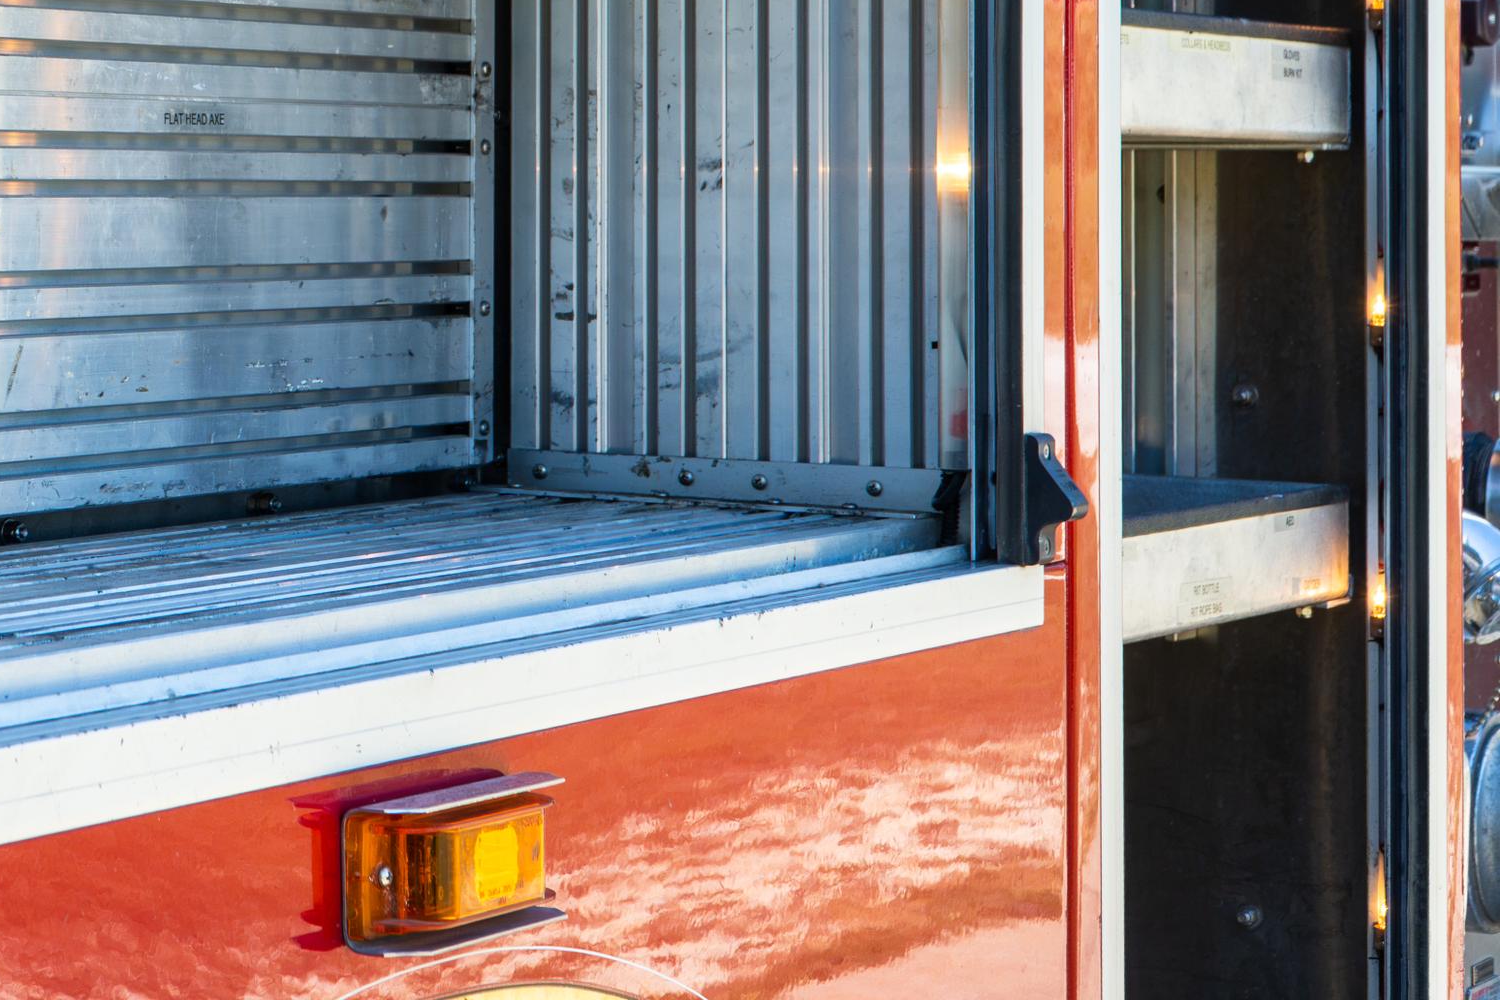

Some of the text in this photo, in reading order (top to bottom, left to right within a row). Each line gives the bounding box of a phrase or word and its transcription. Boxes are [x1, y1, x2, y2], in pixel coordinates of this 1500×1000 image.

[163, 112, 226, 126] FLAT HEAD AXE
